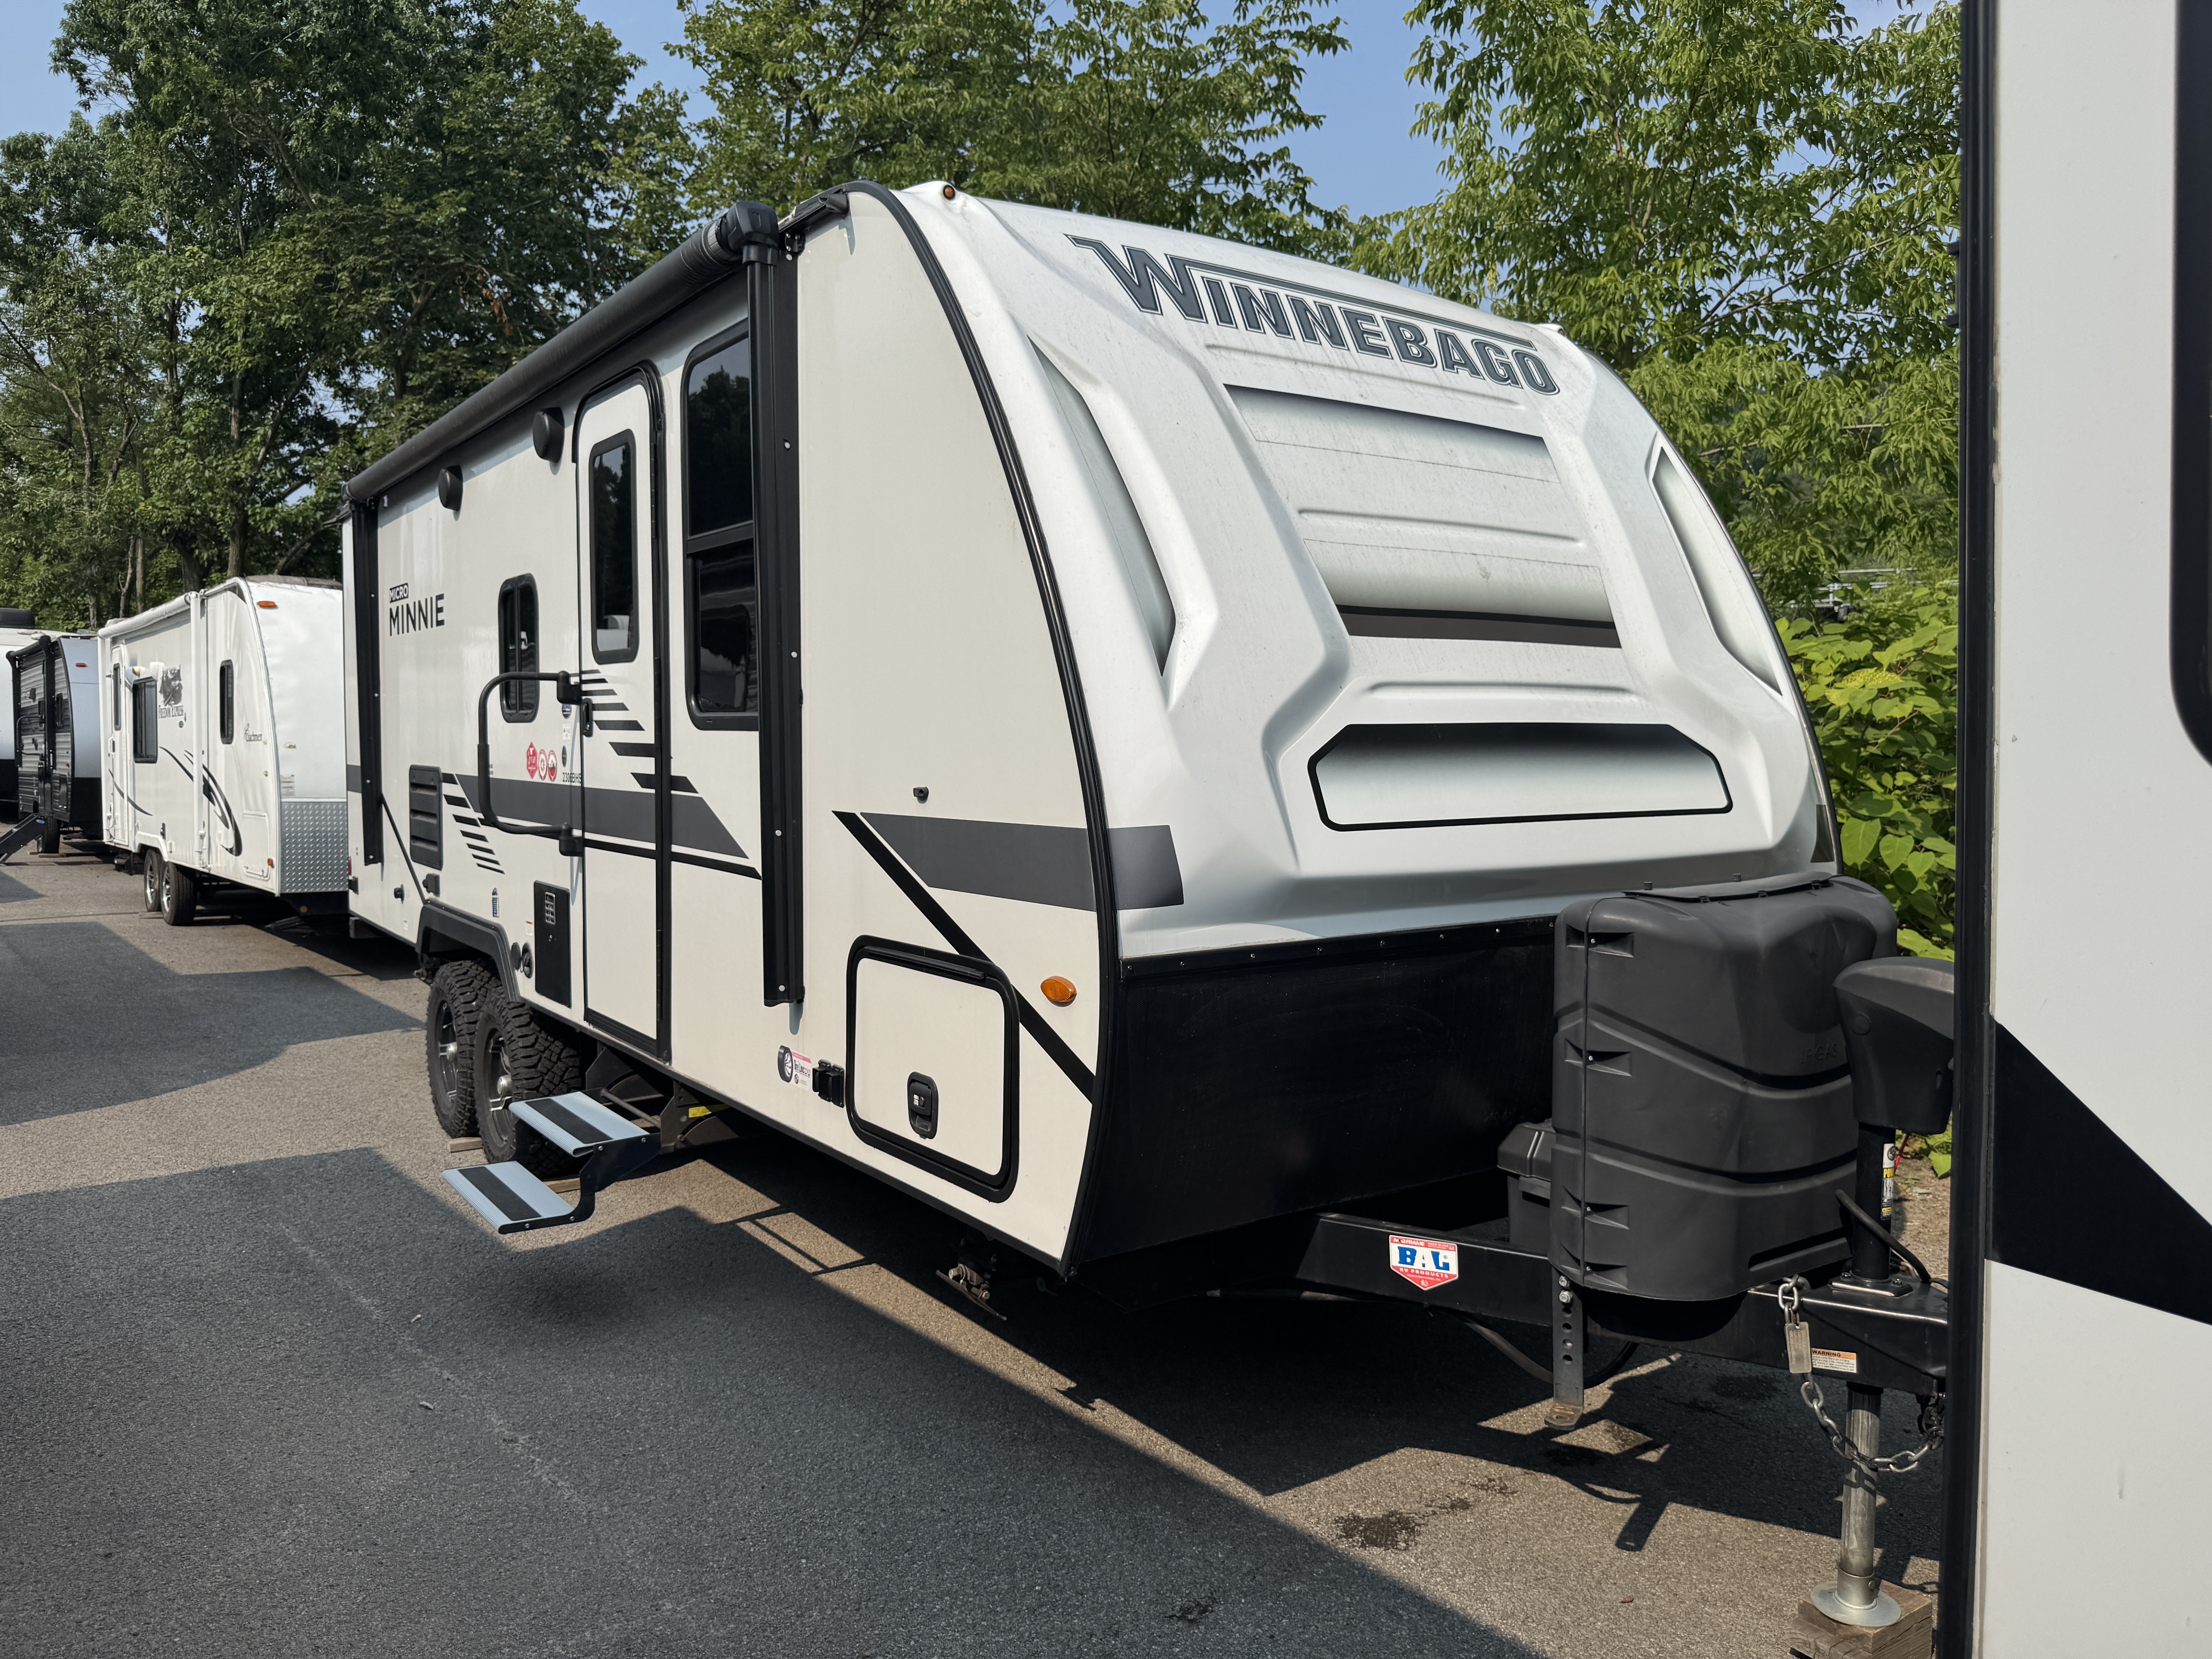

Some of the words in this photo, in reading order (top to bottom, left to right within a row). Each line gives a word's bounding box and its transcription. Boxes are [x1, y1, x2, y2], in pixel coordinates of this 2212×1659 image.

[1065, 234, 1560, 396] WINNEBAGO
[390, 584, 408, 601] MICRO
[390, 593, 445, 636] MINNIE
[1815, 1043, 1837, 1060] GAS
[1398, 1246, 1449, 1271] BAL
[1411, 1269, 1448, 1278] PRODUCTS
